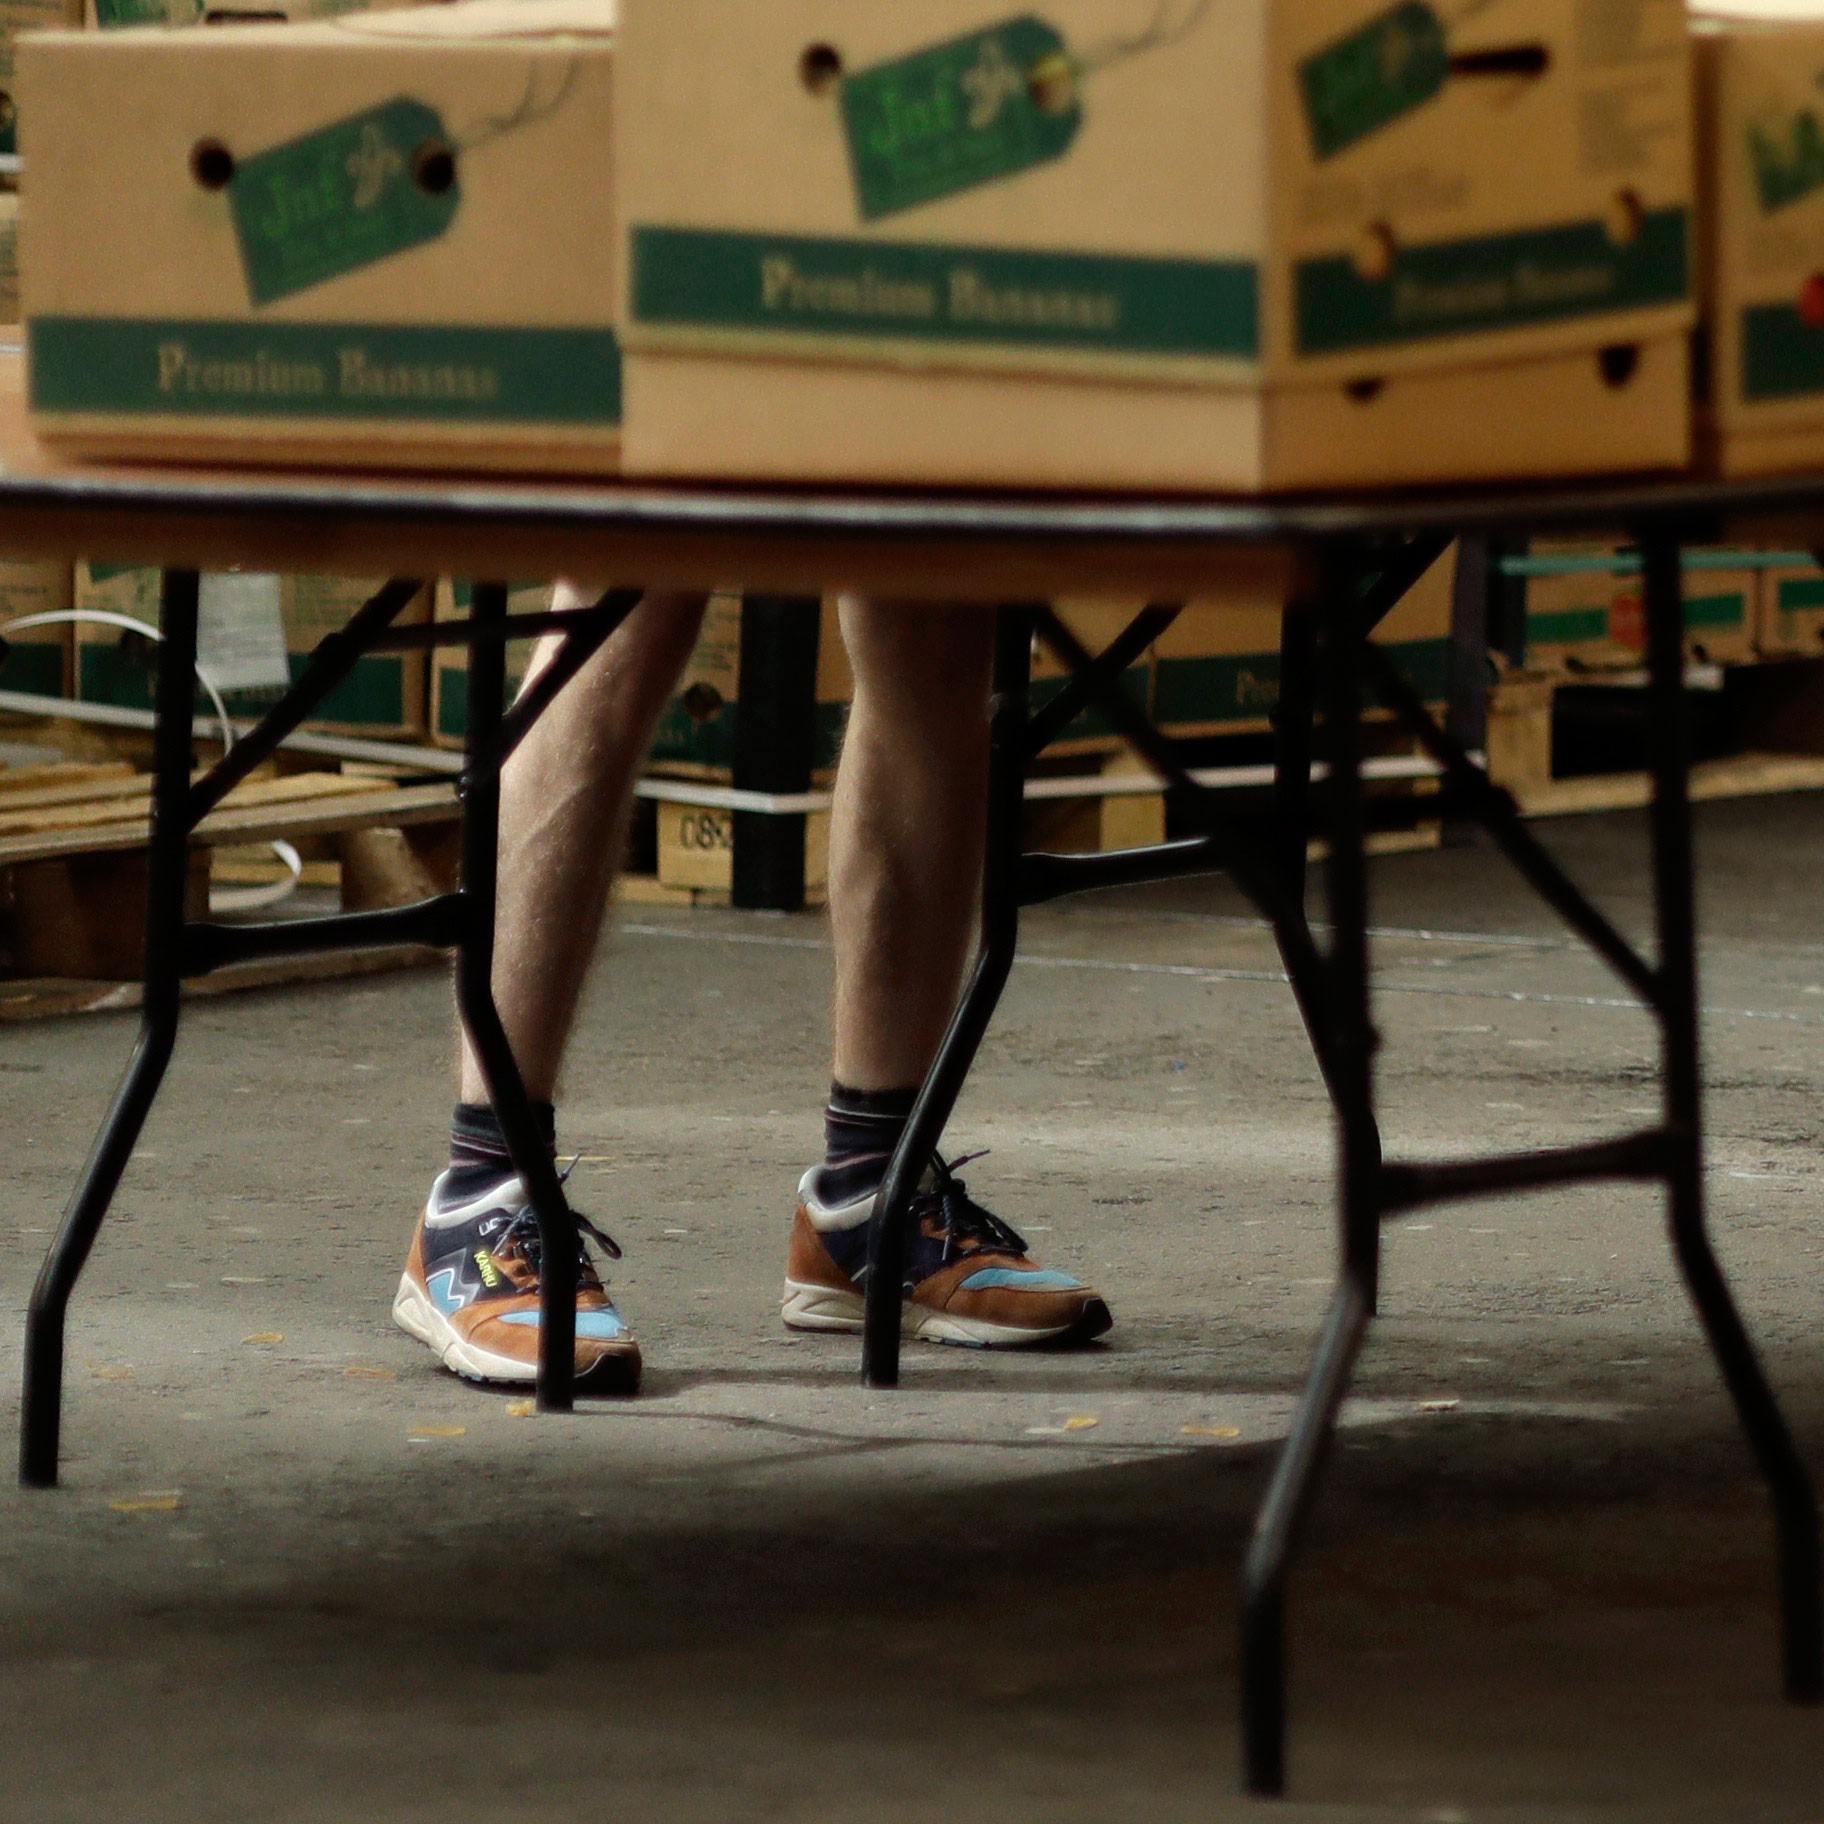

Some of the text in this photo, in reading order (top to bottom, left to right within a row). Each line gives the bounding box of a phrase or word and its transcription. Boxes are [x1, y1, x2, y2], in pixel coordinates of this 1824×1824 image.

[761, 256, 1121, 332] Premium Bananas
[158, 343, 499, 400] Premium Bananas
[473, 1250, 498, 1287] KARHU
